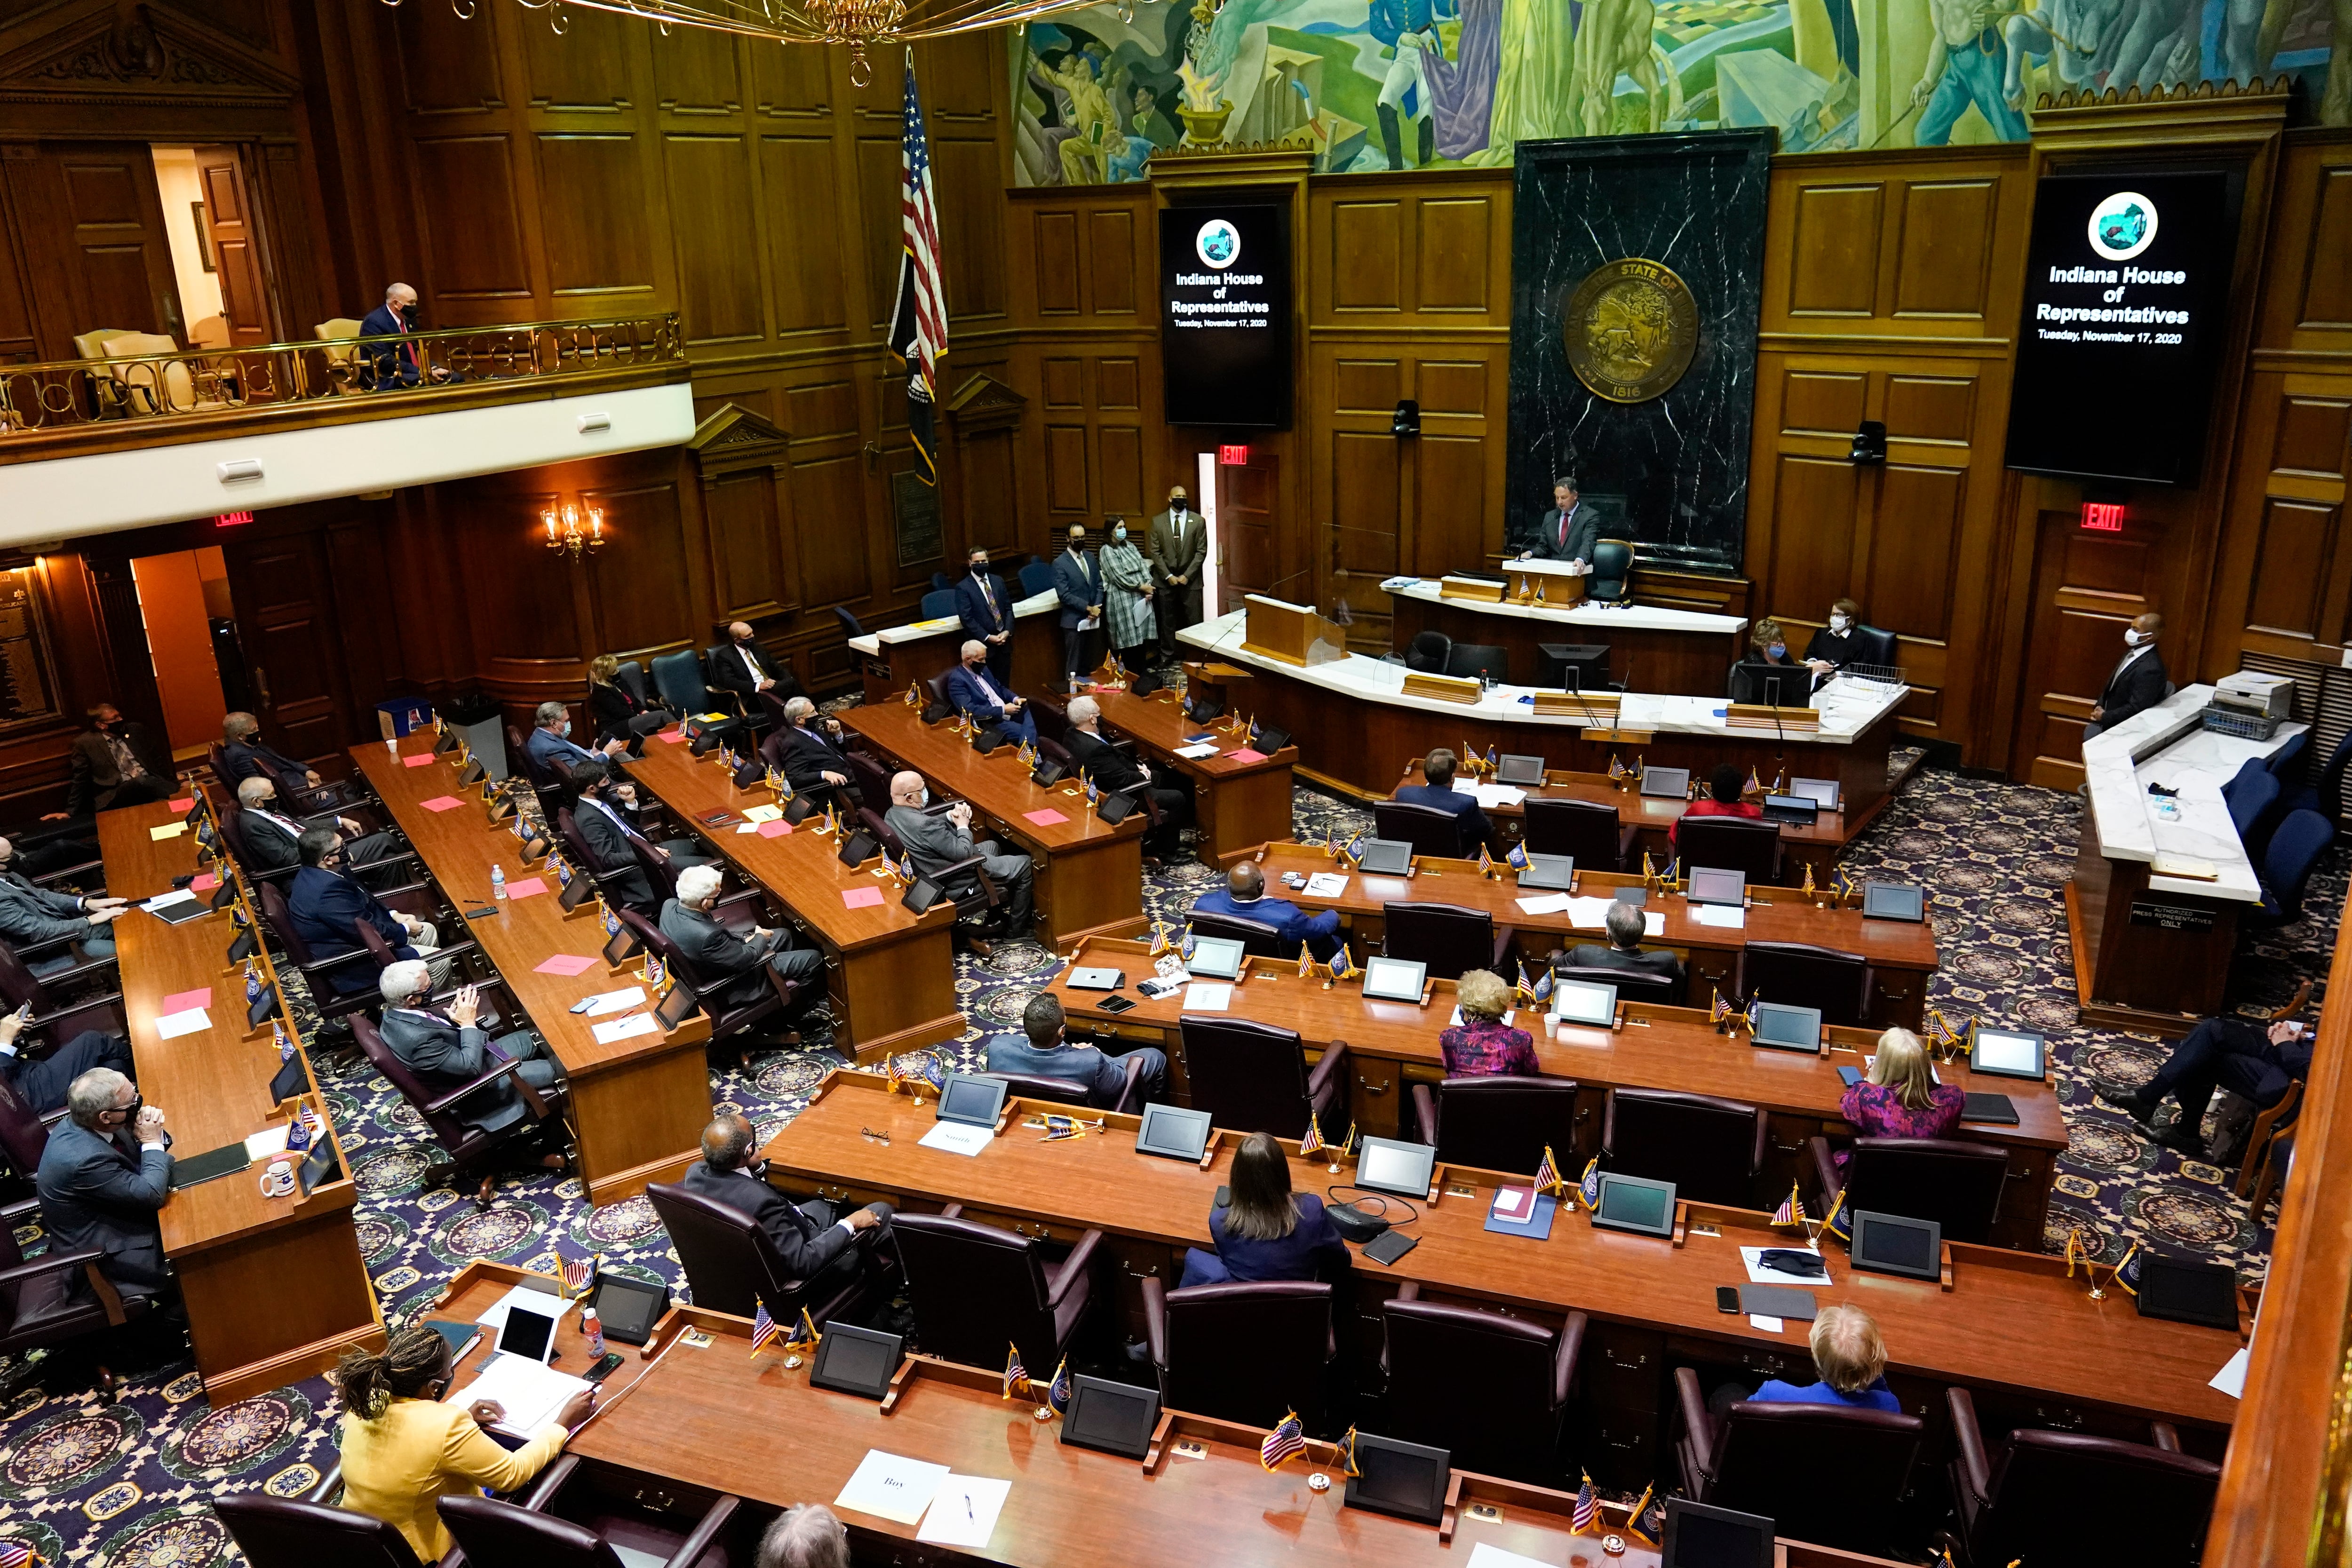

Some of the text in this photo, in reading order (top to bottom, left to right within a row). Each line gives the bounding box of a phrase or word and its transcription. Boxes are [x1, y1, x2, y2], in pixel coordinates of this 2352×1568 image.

[1176, 273, 1263, 285] Indiana House
[1621, 264, 1659, 279] STATE
[1660, 275, 1677, 290] OF
[2050, 266, 2186, 284] Indiana House
[1213, 287, 1226, 299] of
[2103, 286, 2125, 302] of
[1171, 301, 1269, 316] Representatives
[2037, 303, 2189, 324] Representatives
[1174, 319, 1203, 328] Tuesday,
[1239, 319, 1249, 328] 17,
[2038, 329, 2182, 344] Tuesday, November 17, 2020
[1613, 386, 1641, 397] 1816
[1224, 446, 1244, 463] EXIT
[2087, 504, 2120, 528] EXIT
[2154, 907, 2193, 916] AUTHORIZED
[2154, 913, 2213, 924] REPRESENTATIVES
[2160, 919, 2182, 928] ONLY
[945, 1134, 970, 1144] Smith
[884, 1477, 906, 1490] Boy
